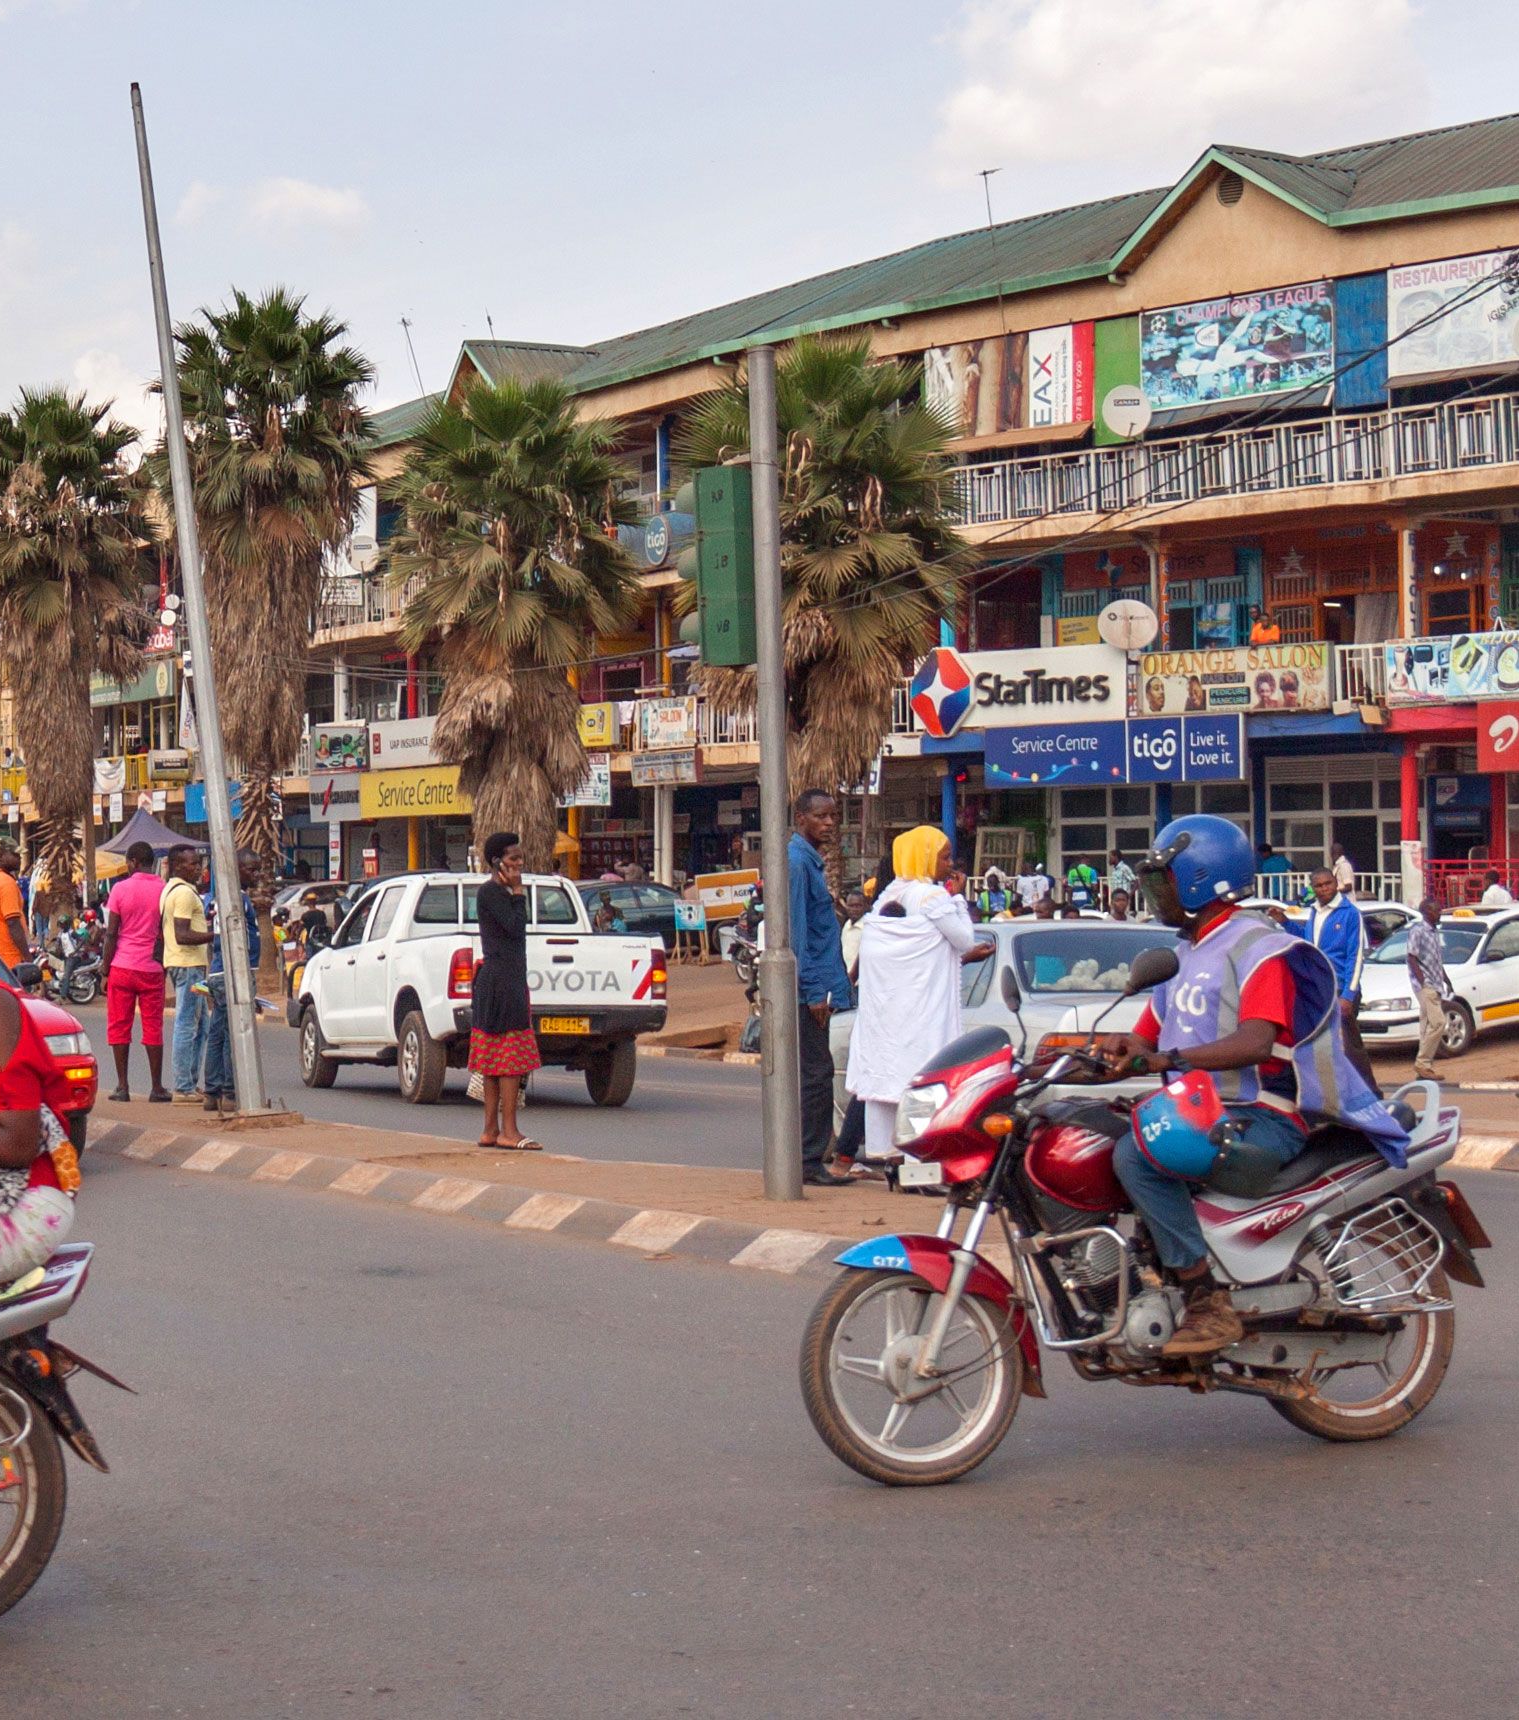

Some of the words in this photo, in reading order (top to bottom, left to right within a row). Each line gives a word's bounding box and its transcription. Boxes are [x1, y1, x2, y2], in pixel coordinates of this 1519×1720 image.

[1392, 259, 1488, 289] RESTAURENT
[1175, 297, 1262, 325] CHAMPIONS
[1266, 285, 1326, 310] LEAGUE
[1033, 353, 1052, 426] EAX
[1143, 650, 1236, 676] ORANGE
[1247, 643, 1325, 670] SALON
[976, 668, 1111, 706] StarTimes
[389, 739, 400, 750] UAP
[1012, 736, 1054, 754] Service
[1056, 734, 1098, 752] Centre
[1190, 732, 1214, 747] Live
[1216, 731, 1229, 747] it.
[1190, 750, 1219, 766] Love
[1221, 749, 1234, 765] it.
[378, 781, 415, 807] Service
[417, 779, 454, 805] Centre
[526, 970, 621, 992] OYOTA
[1251, 1204, 1302, 1232] Victor
[873, 1254, 906, 1268] CITY
